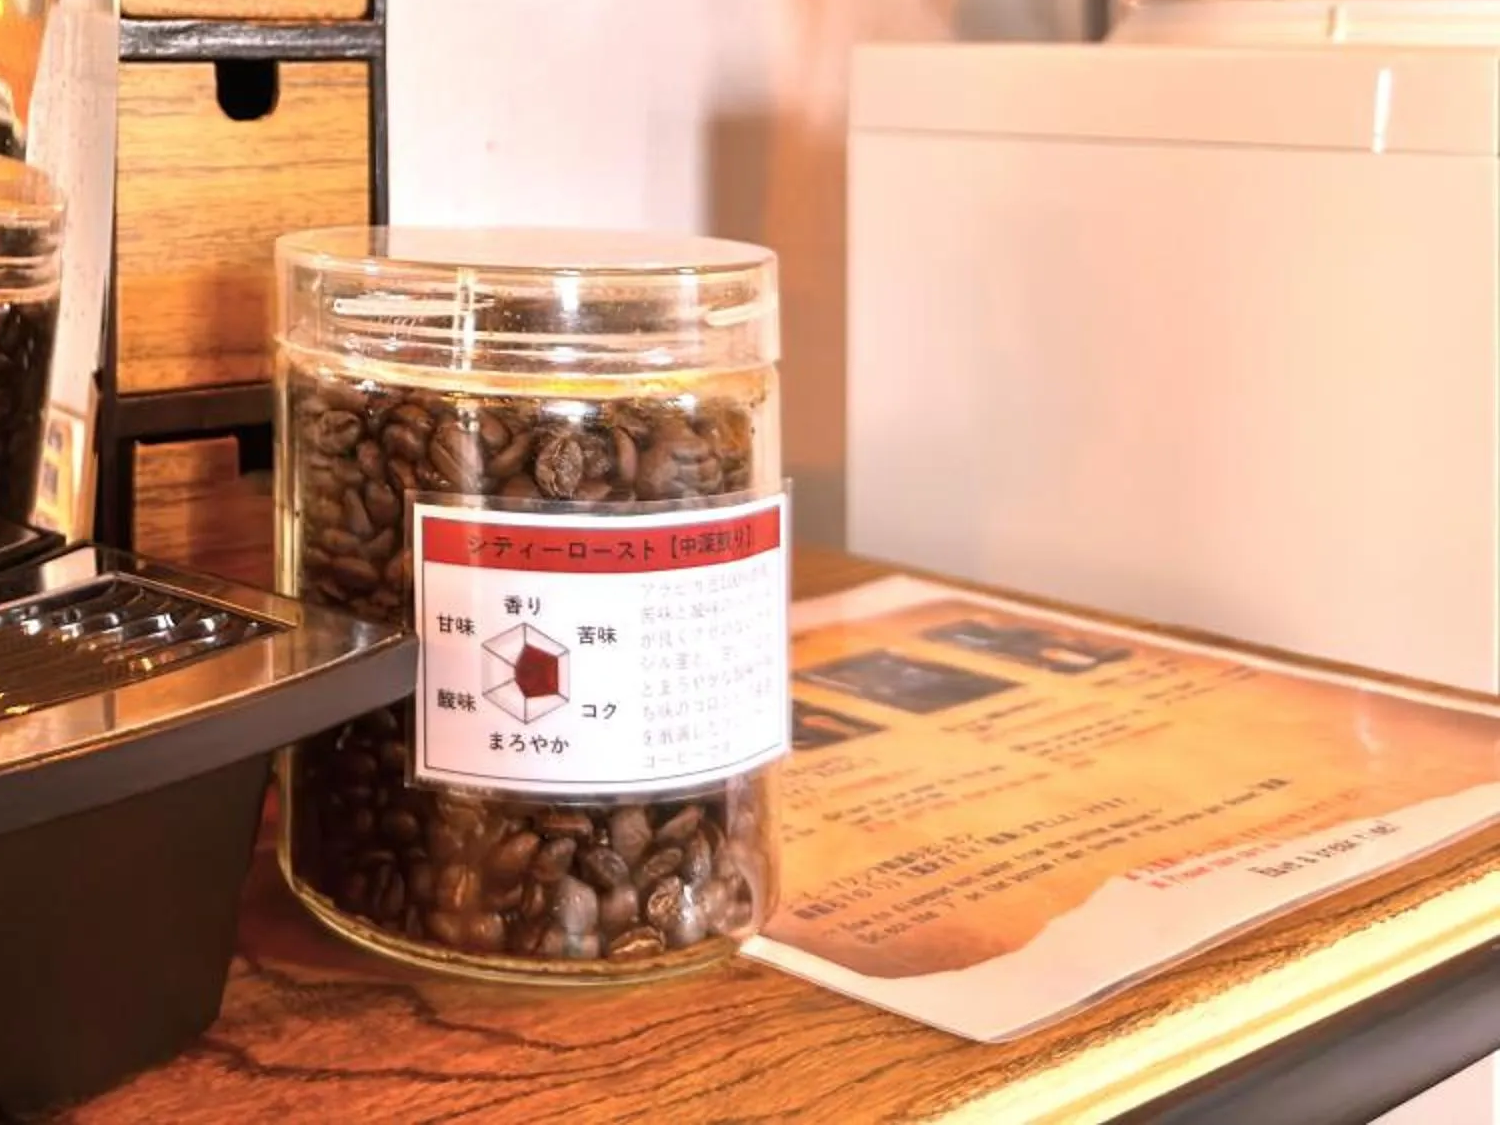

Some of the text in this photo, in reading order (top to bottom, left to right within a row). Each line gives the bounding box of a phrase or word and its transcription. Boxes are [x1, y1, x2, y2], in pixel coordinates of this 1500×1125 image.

[504, 594, 541, 616] 香り
[436, 613, 476, 636] 甘味
[577, 625, 618, 645] 苦味
[437, 688, 477, 712] 酸味
[581, 702, 618, 720] コク
[489, 731, 570, 754] まろやか
